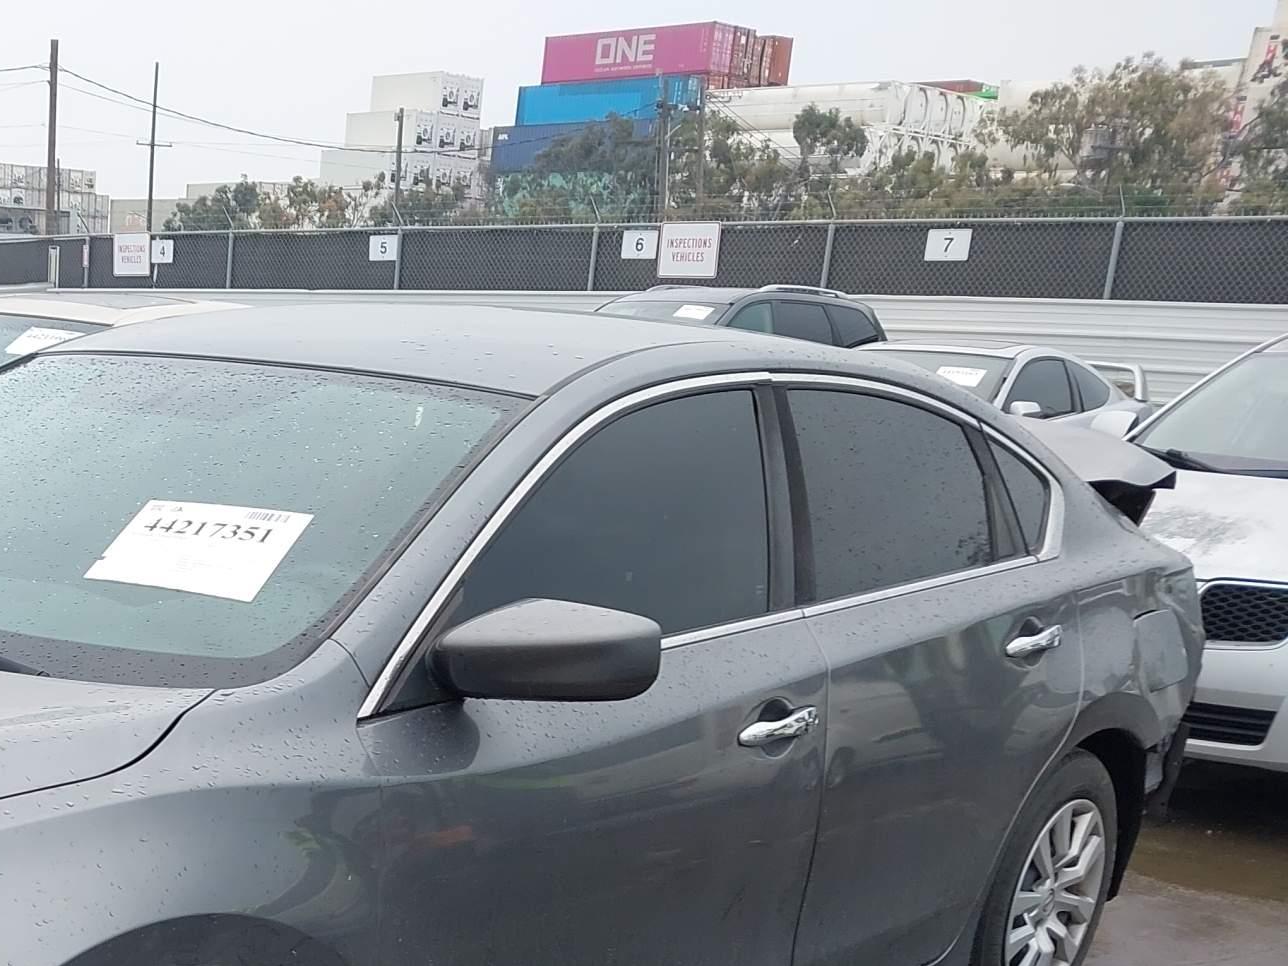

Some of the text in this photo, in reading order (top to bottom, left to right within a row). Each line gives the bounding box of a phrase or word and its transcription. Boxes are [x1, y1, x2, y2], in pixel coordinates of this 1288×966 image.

[595, 34, 656, 64] ONE
[380, 241, 387, 254] 5
[635, 237, 644, 252] 6
[667, 238, 713, 249] INSPECTIONS
[944, 237, 954, 252] 7
[160, 245, 165, 257] 4
[672, 252, 705, 262] VEHICLES
[144, 517, 273, 543] 44217351
